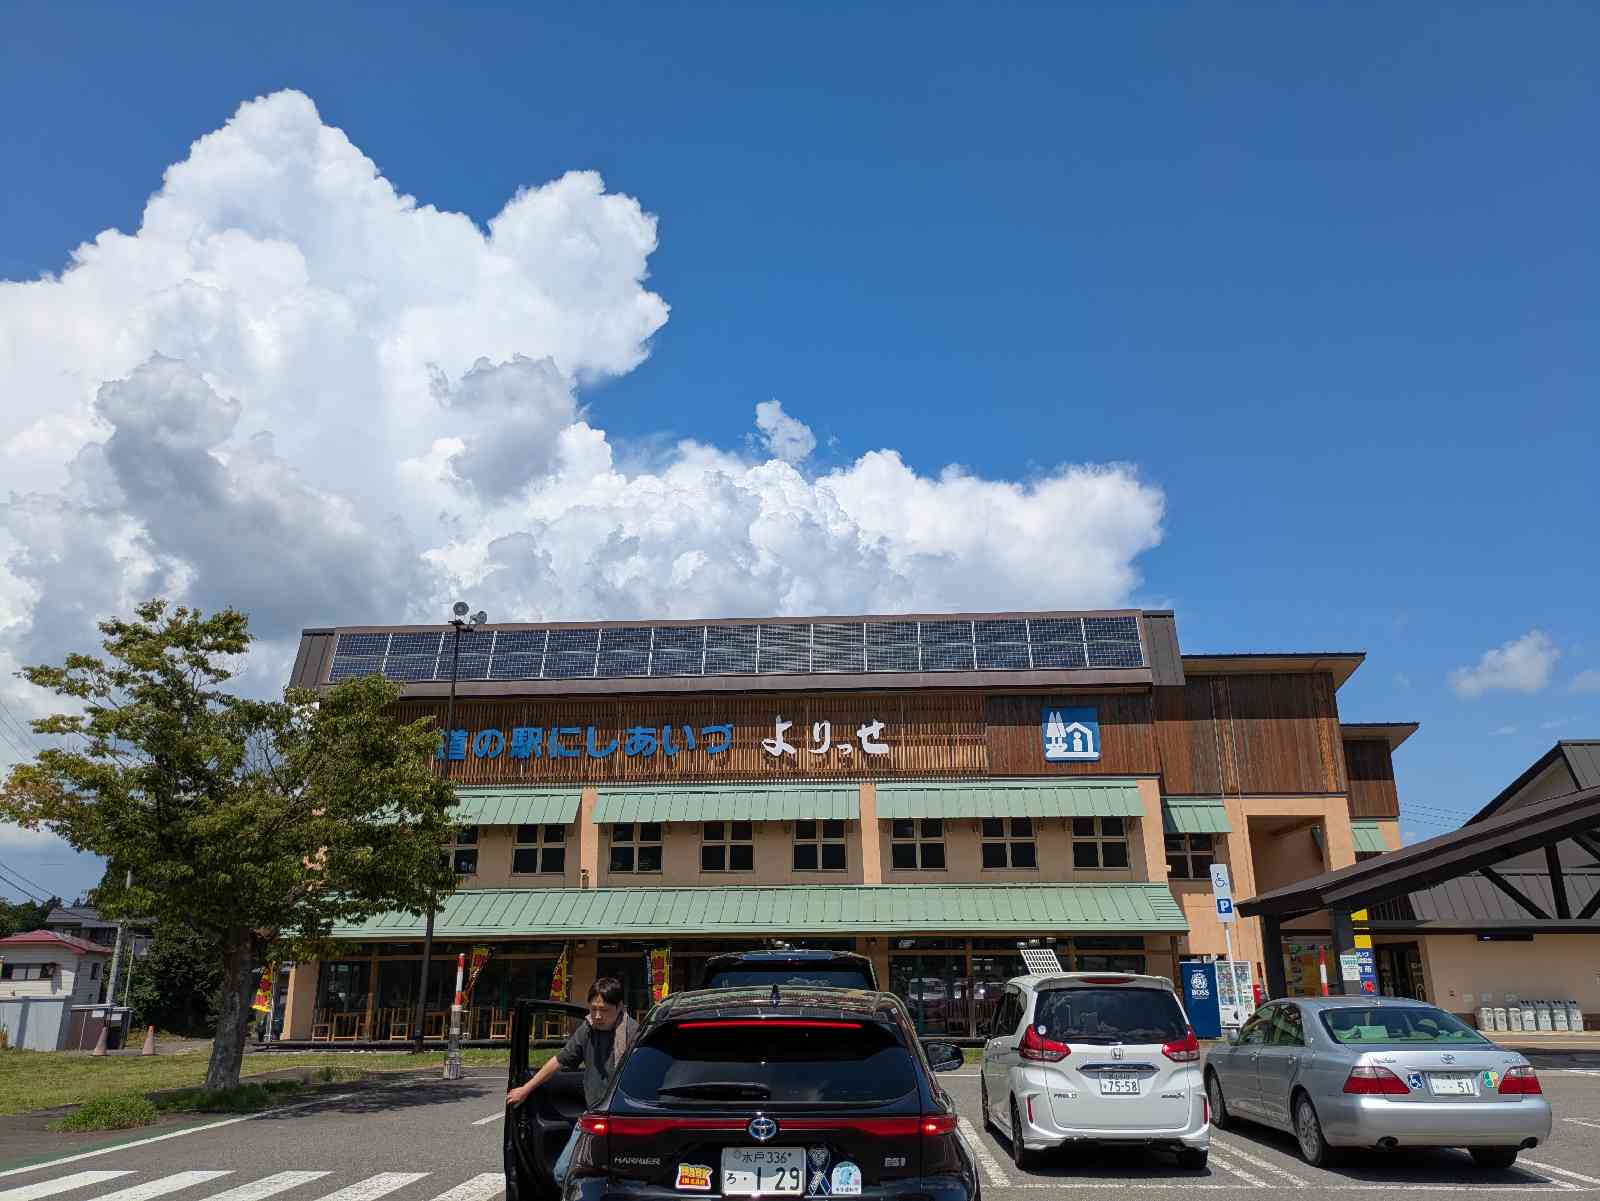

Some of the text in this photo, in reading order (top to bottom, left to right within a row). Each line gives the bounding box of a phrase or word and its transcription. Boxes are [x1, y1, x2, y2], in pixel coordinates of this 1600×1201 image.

[762, 715, 888, 757] よりっせ
[1220, 900, 1230, 912] P
[1109, 1080, 1138, 1092] 75-58
